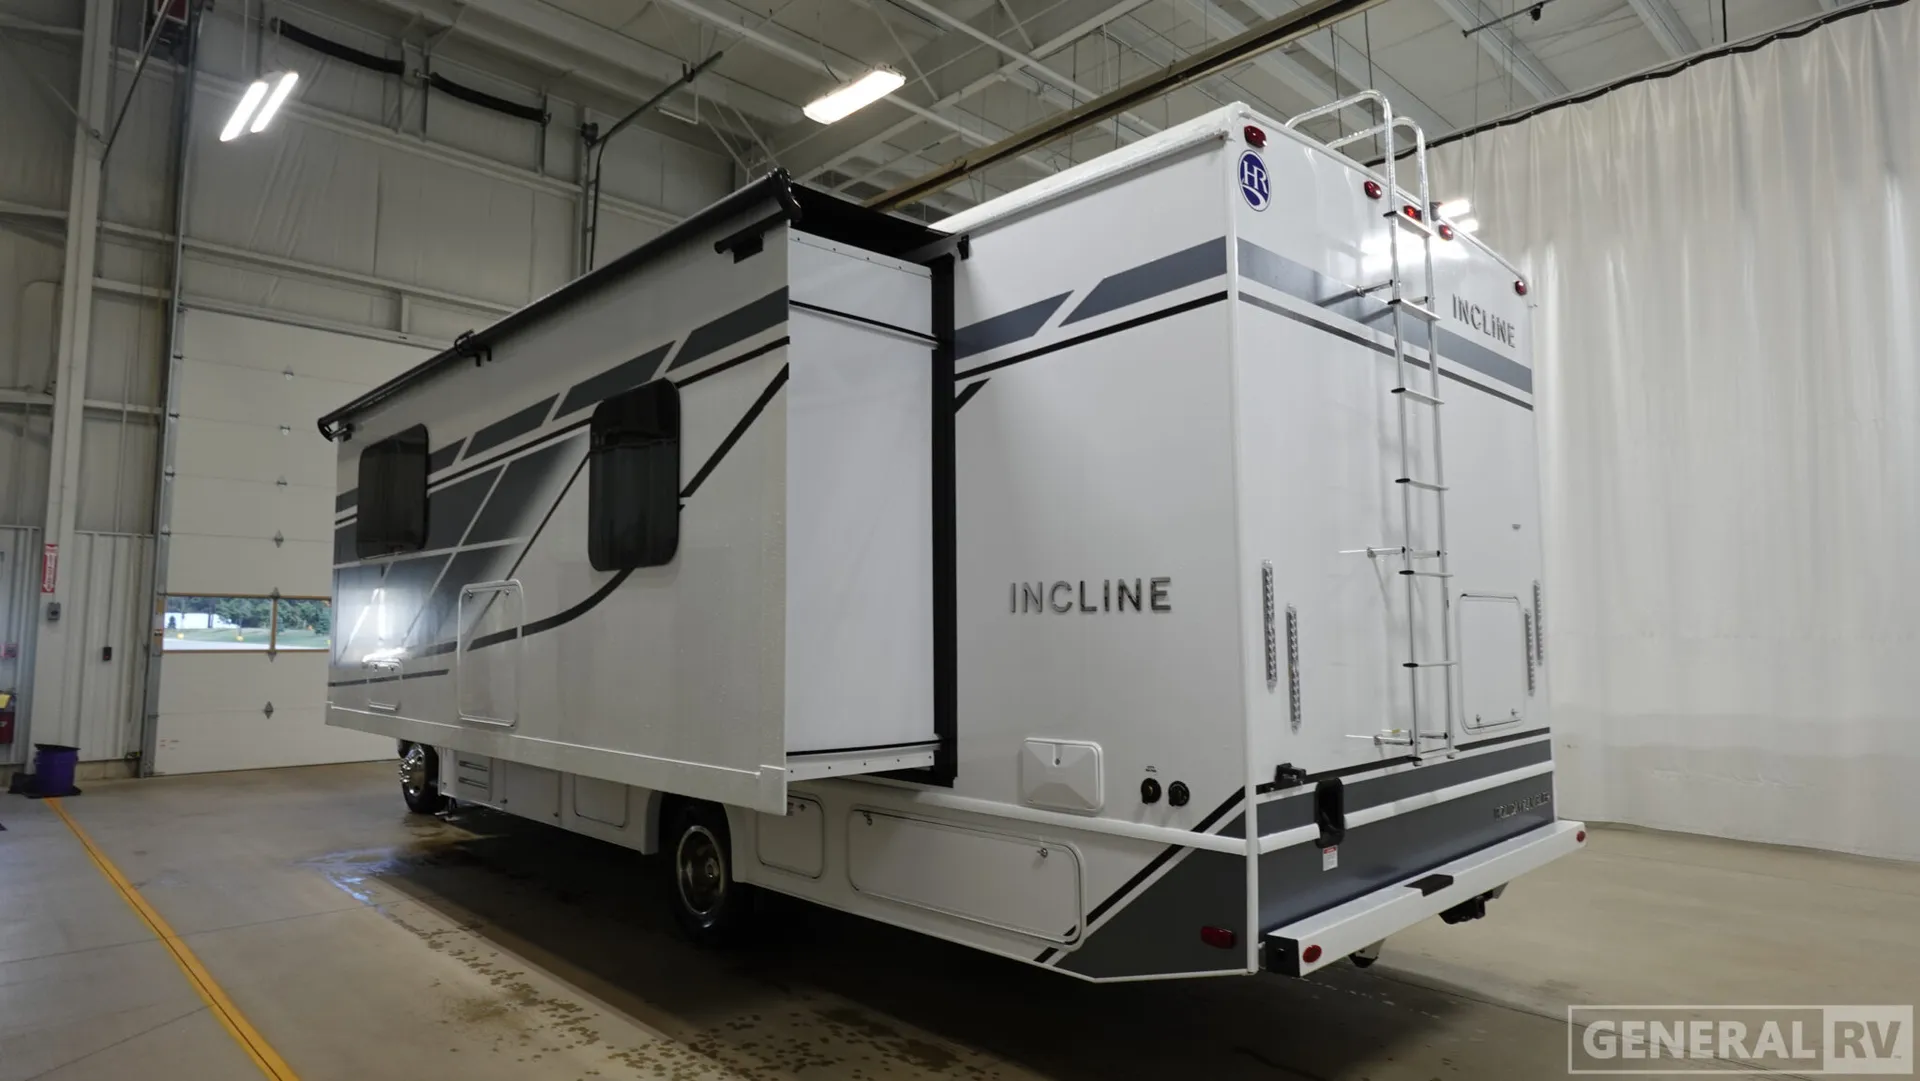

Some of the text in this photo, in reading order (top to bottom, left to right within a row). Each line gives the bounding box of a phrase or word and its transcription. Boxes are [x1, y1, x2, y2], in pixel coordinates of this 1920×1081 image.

[1242, 160, 1268, 194] HR
[1452, 293, 1516, 349] INCLINE
[1009, 577, 1172, 613] INCLINE
